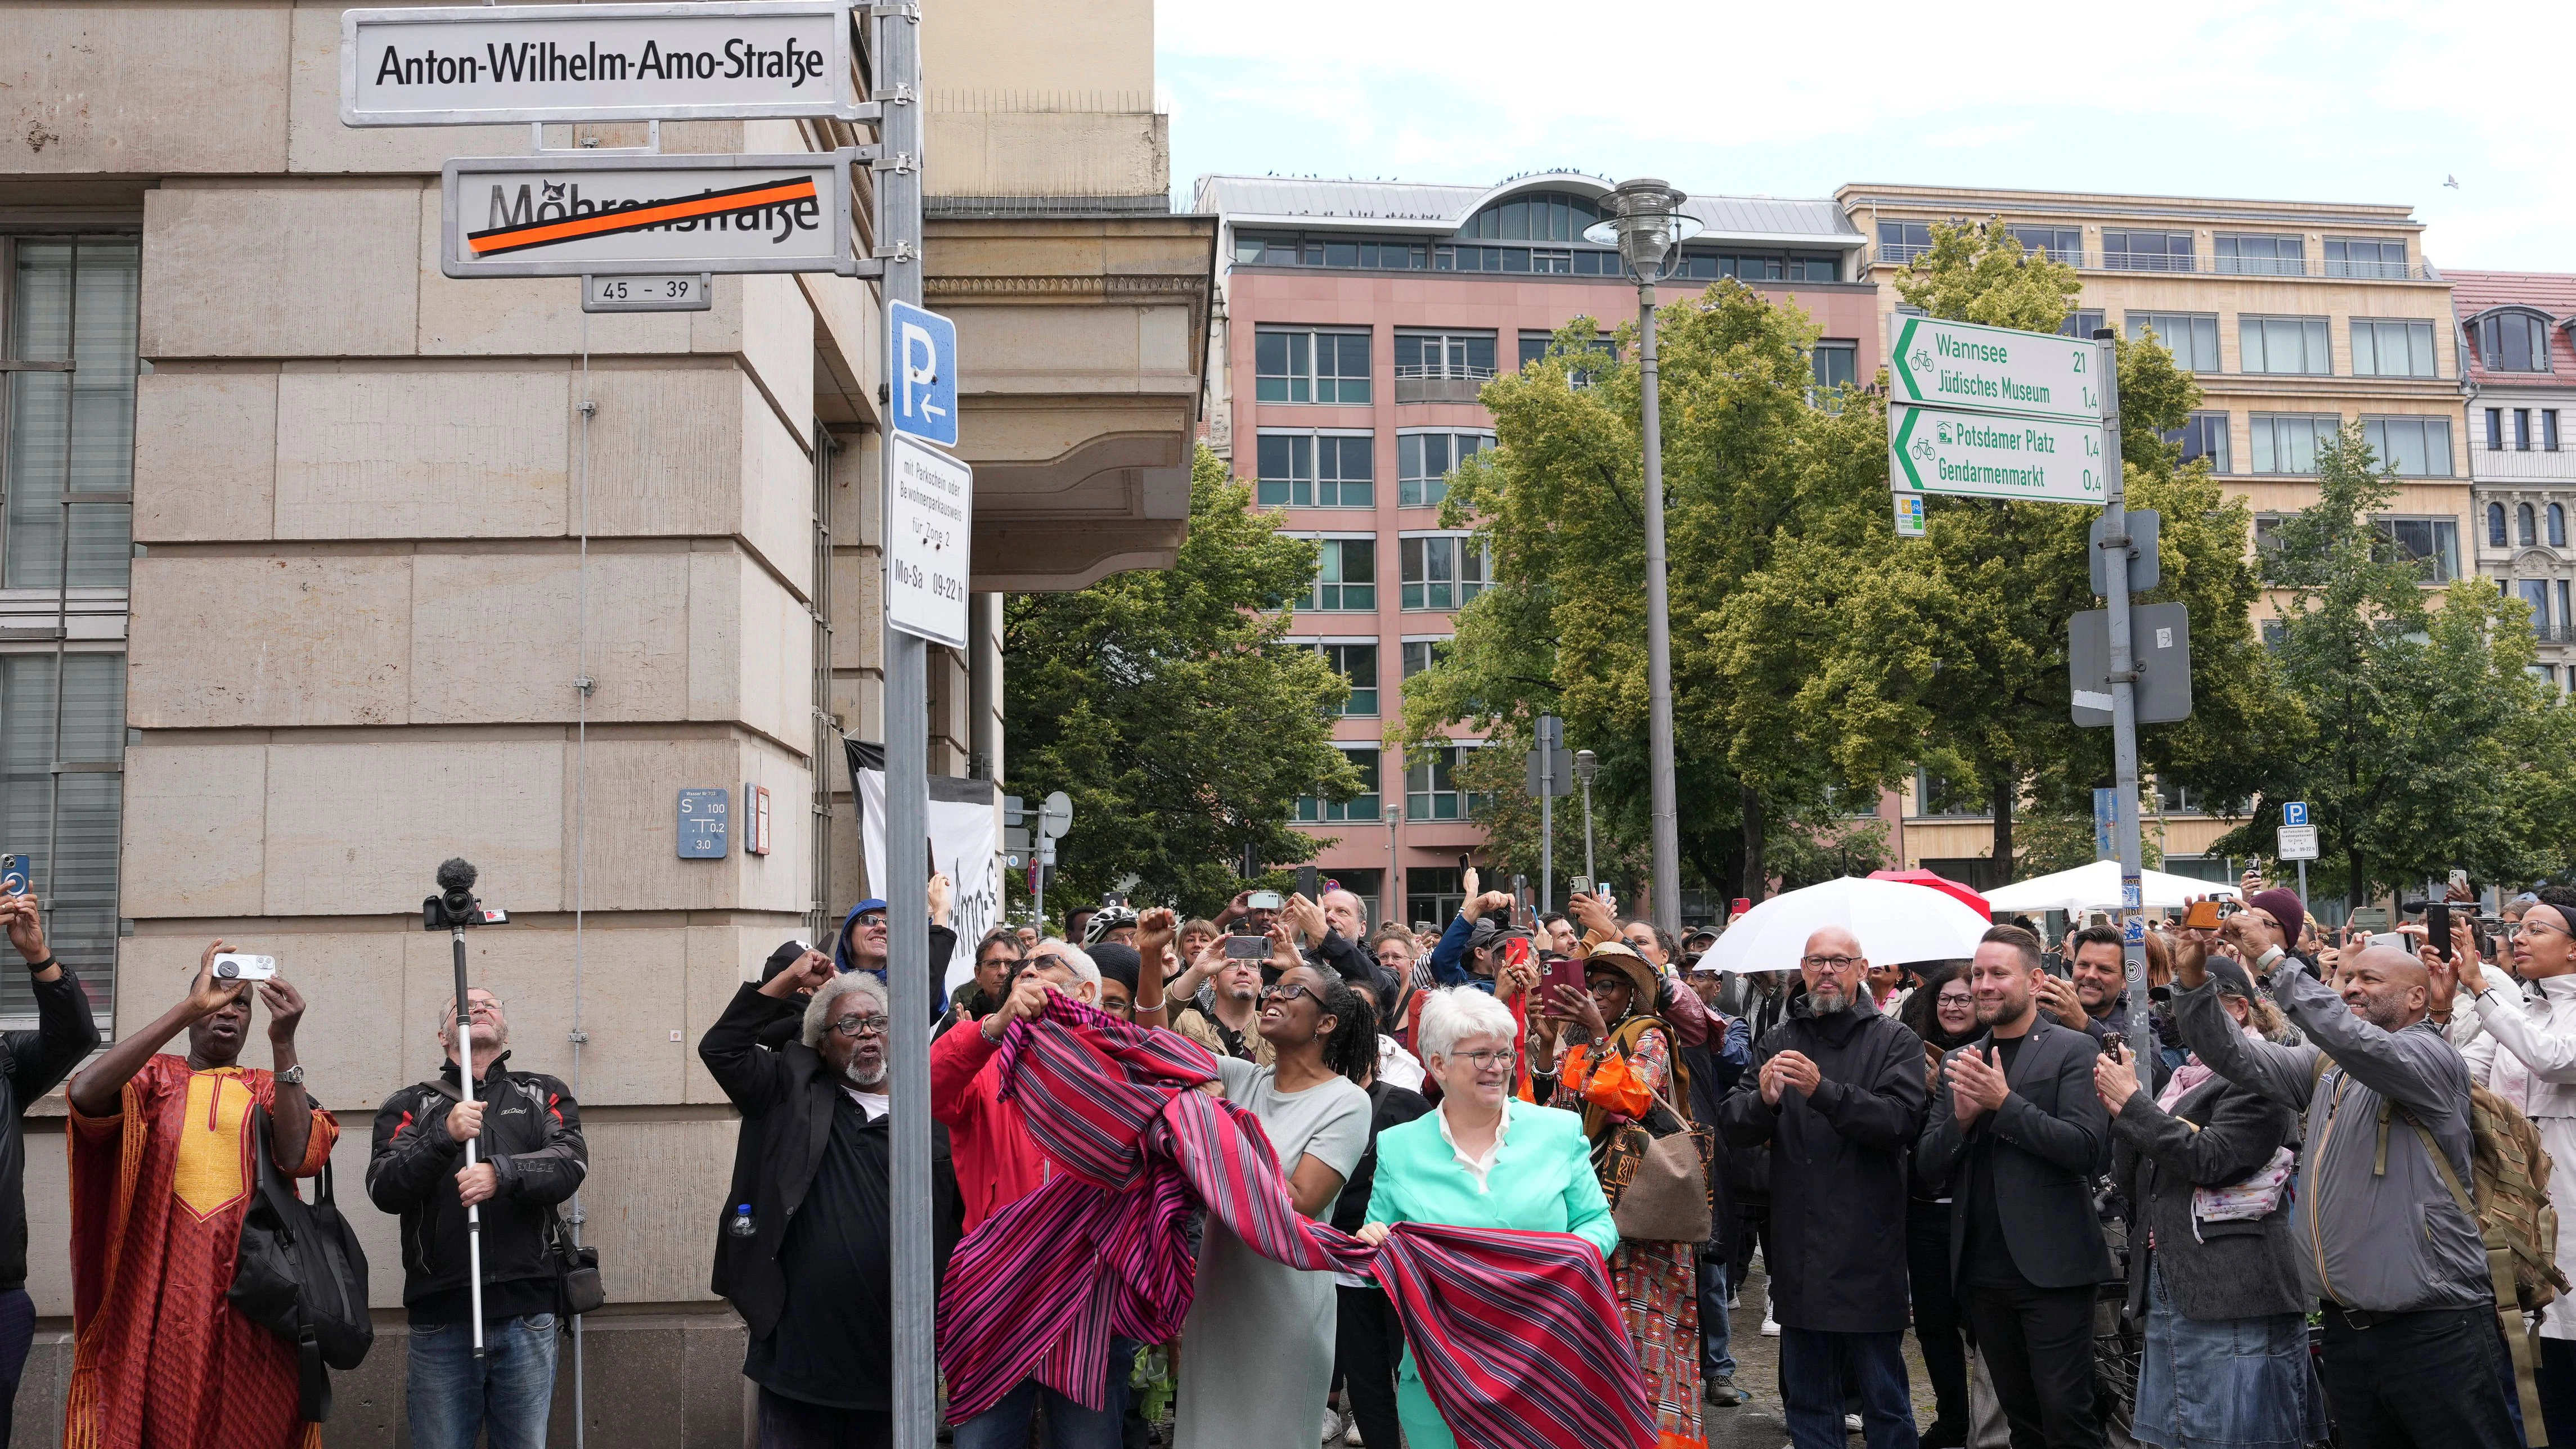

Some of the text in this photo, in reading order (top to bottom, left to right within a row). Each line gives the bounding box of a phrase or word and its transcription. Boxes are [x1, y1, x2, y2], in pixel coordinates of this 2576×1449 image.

[376, 38, 823, 88] Anton-Wilhelm-Amo-Straße
[604, 282, 627, 299] 45
[666, 281, 689, 298] 39
[902, 322, 936, 417] P
[1935, 332, 2085, 374] Wannsee 21
[1938, 369, 2097, 410] Jüdisches Museum 1,4
[1957, 422, 2099, 457] Potsdamer Platz 1,4
[904, 459, 960, 497] mit Parkschein oder
[1939, 457, 2101, 492] Gendarmenmarkt 0,4
[912, 517, 950, 547] für Zone 2
[896, 559, 963, 603] Mo-Sa 09-22 h
[681, 799, 725, 813] S 100
[2290, 805, 2303, 823] P
[696, 840, 711, 849] 3,0
[710, 823, 725, 833] 0,2
